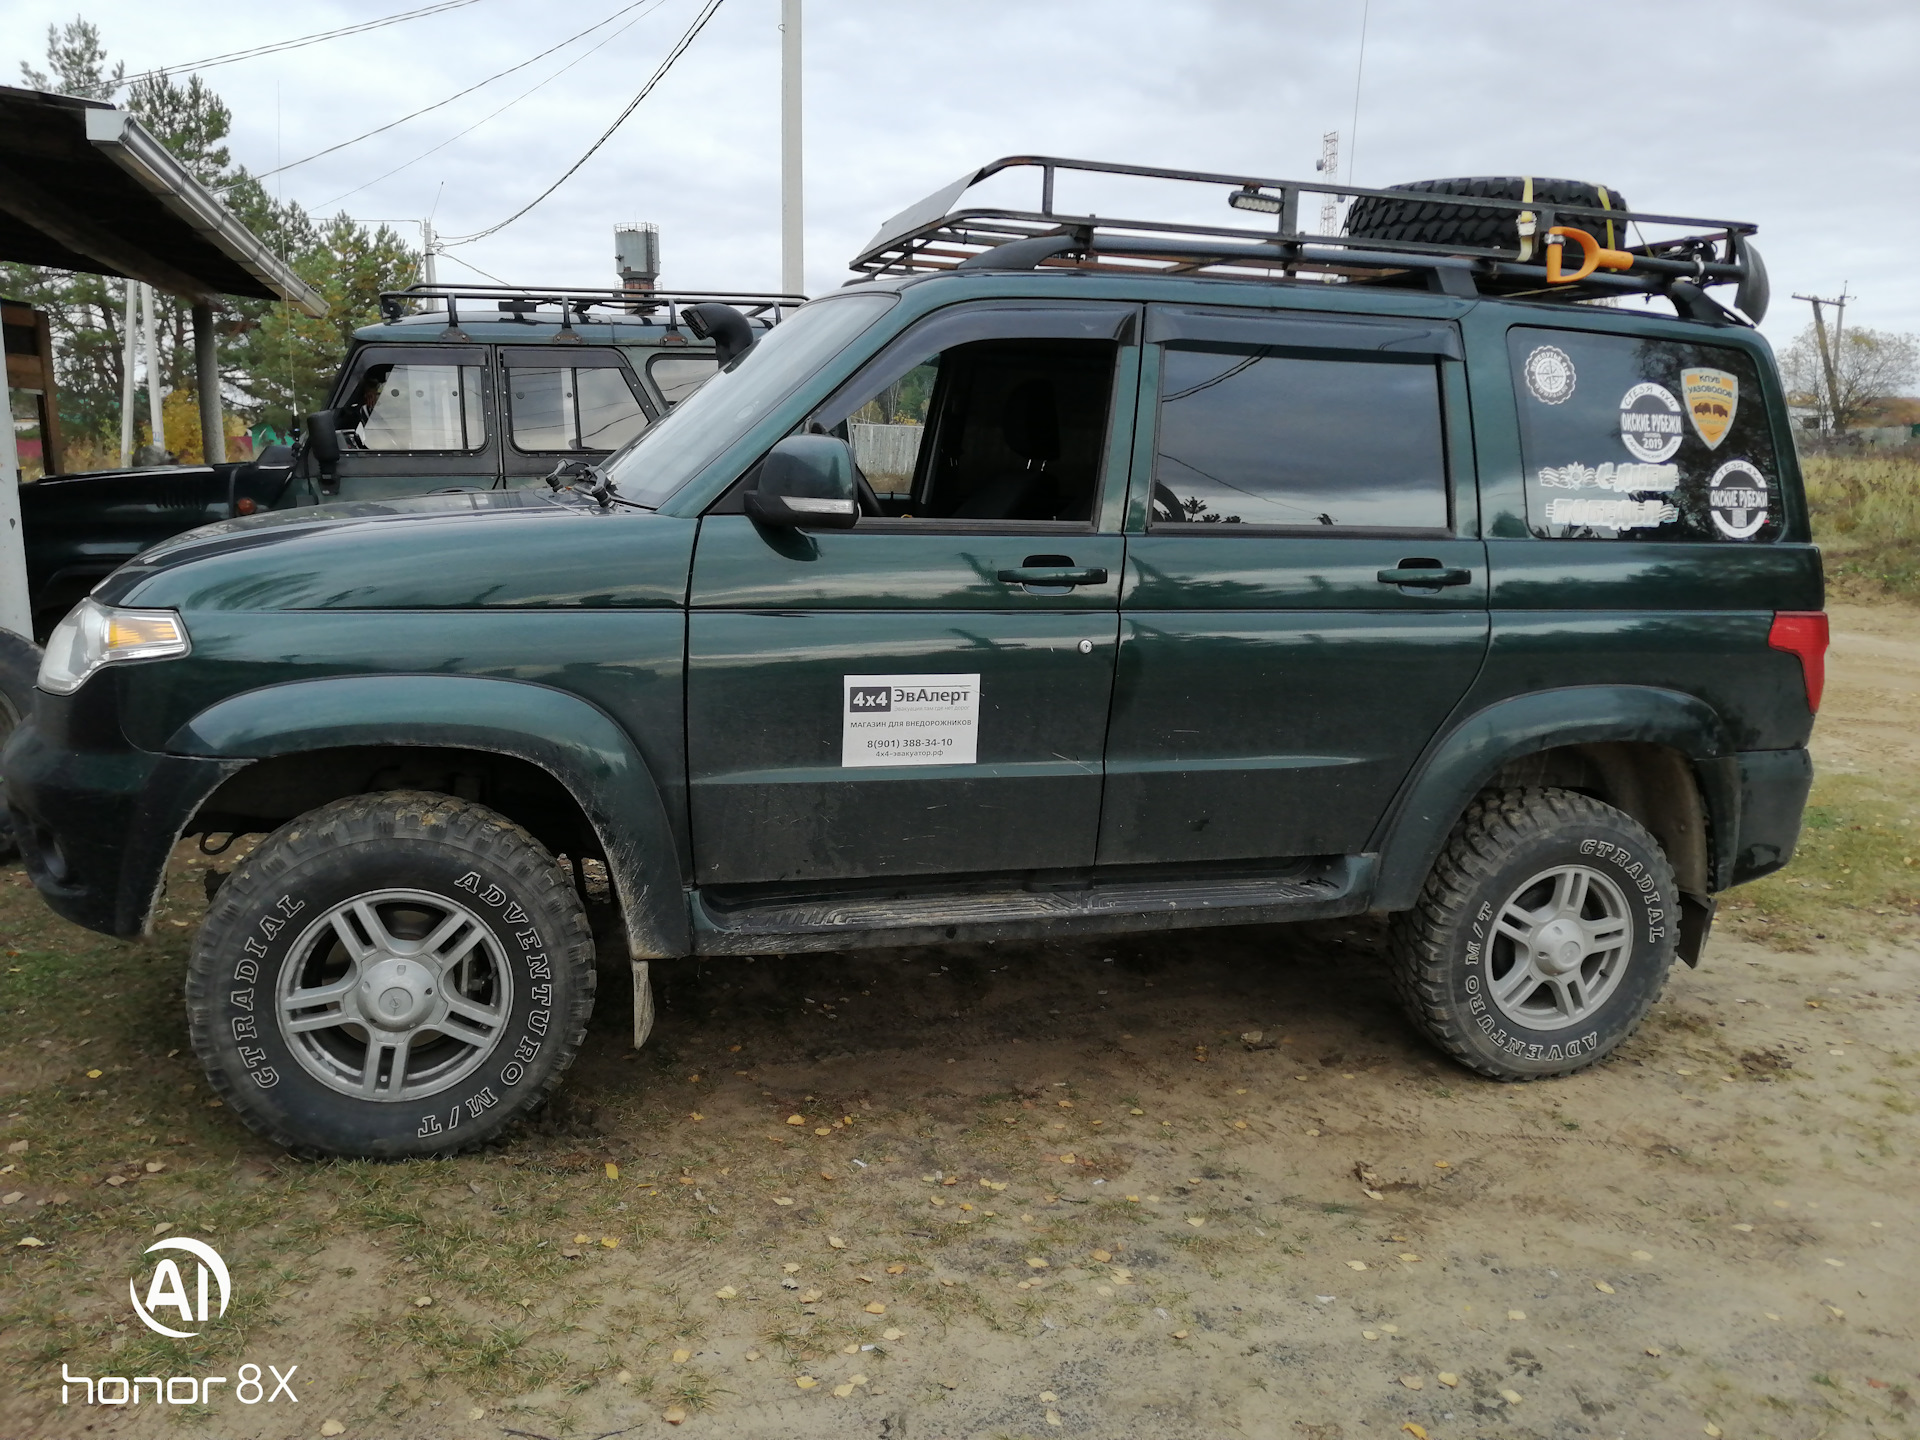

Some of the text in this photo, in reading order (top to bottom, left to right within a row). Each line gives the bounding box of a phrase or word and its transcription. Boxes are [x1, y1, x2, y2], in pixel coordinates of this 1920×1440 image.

[1699, 375, 1720, 384] КЛУБ
[1624, 385, 1653, 407] СТЕЗЯ
[1621, 412, 1682, 434] ОКСКИЕ РУБЕЖИ
[1642, 437, 1663, 450] 2019
[1714, 463, 1744, 484] СТЕЗЯ
[1710, 489, 1768, 508] ОКСКИЕ РУБЕЖИ
[853, 688, 970, 707] 4x4 ЭвАлерт
[887, 720, 904, 728] ДЛЯ
[905, 719, 972, 728] ВНЕДОРОЖНИКОВ
[867, 738, 953, 749] 8(901) 388-34-10
[454, 871, 552, 1086] ADVENTURO
[1465, 974, 1599, 1061] ADVENTURO
